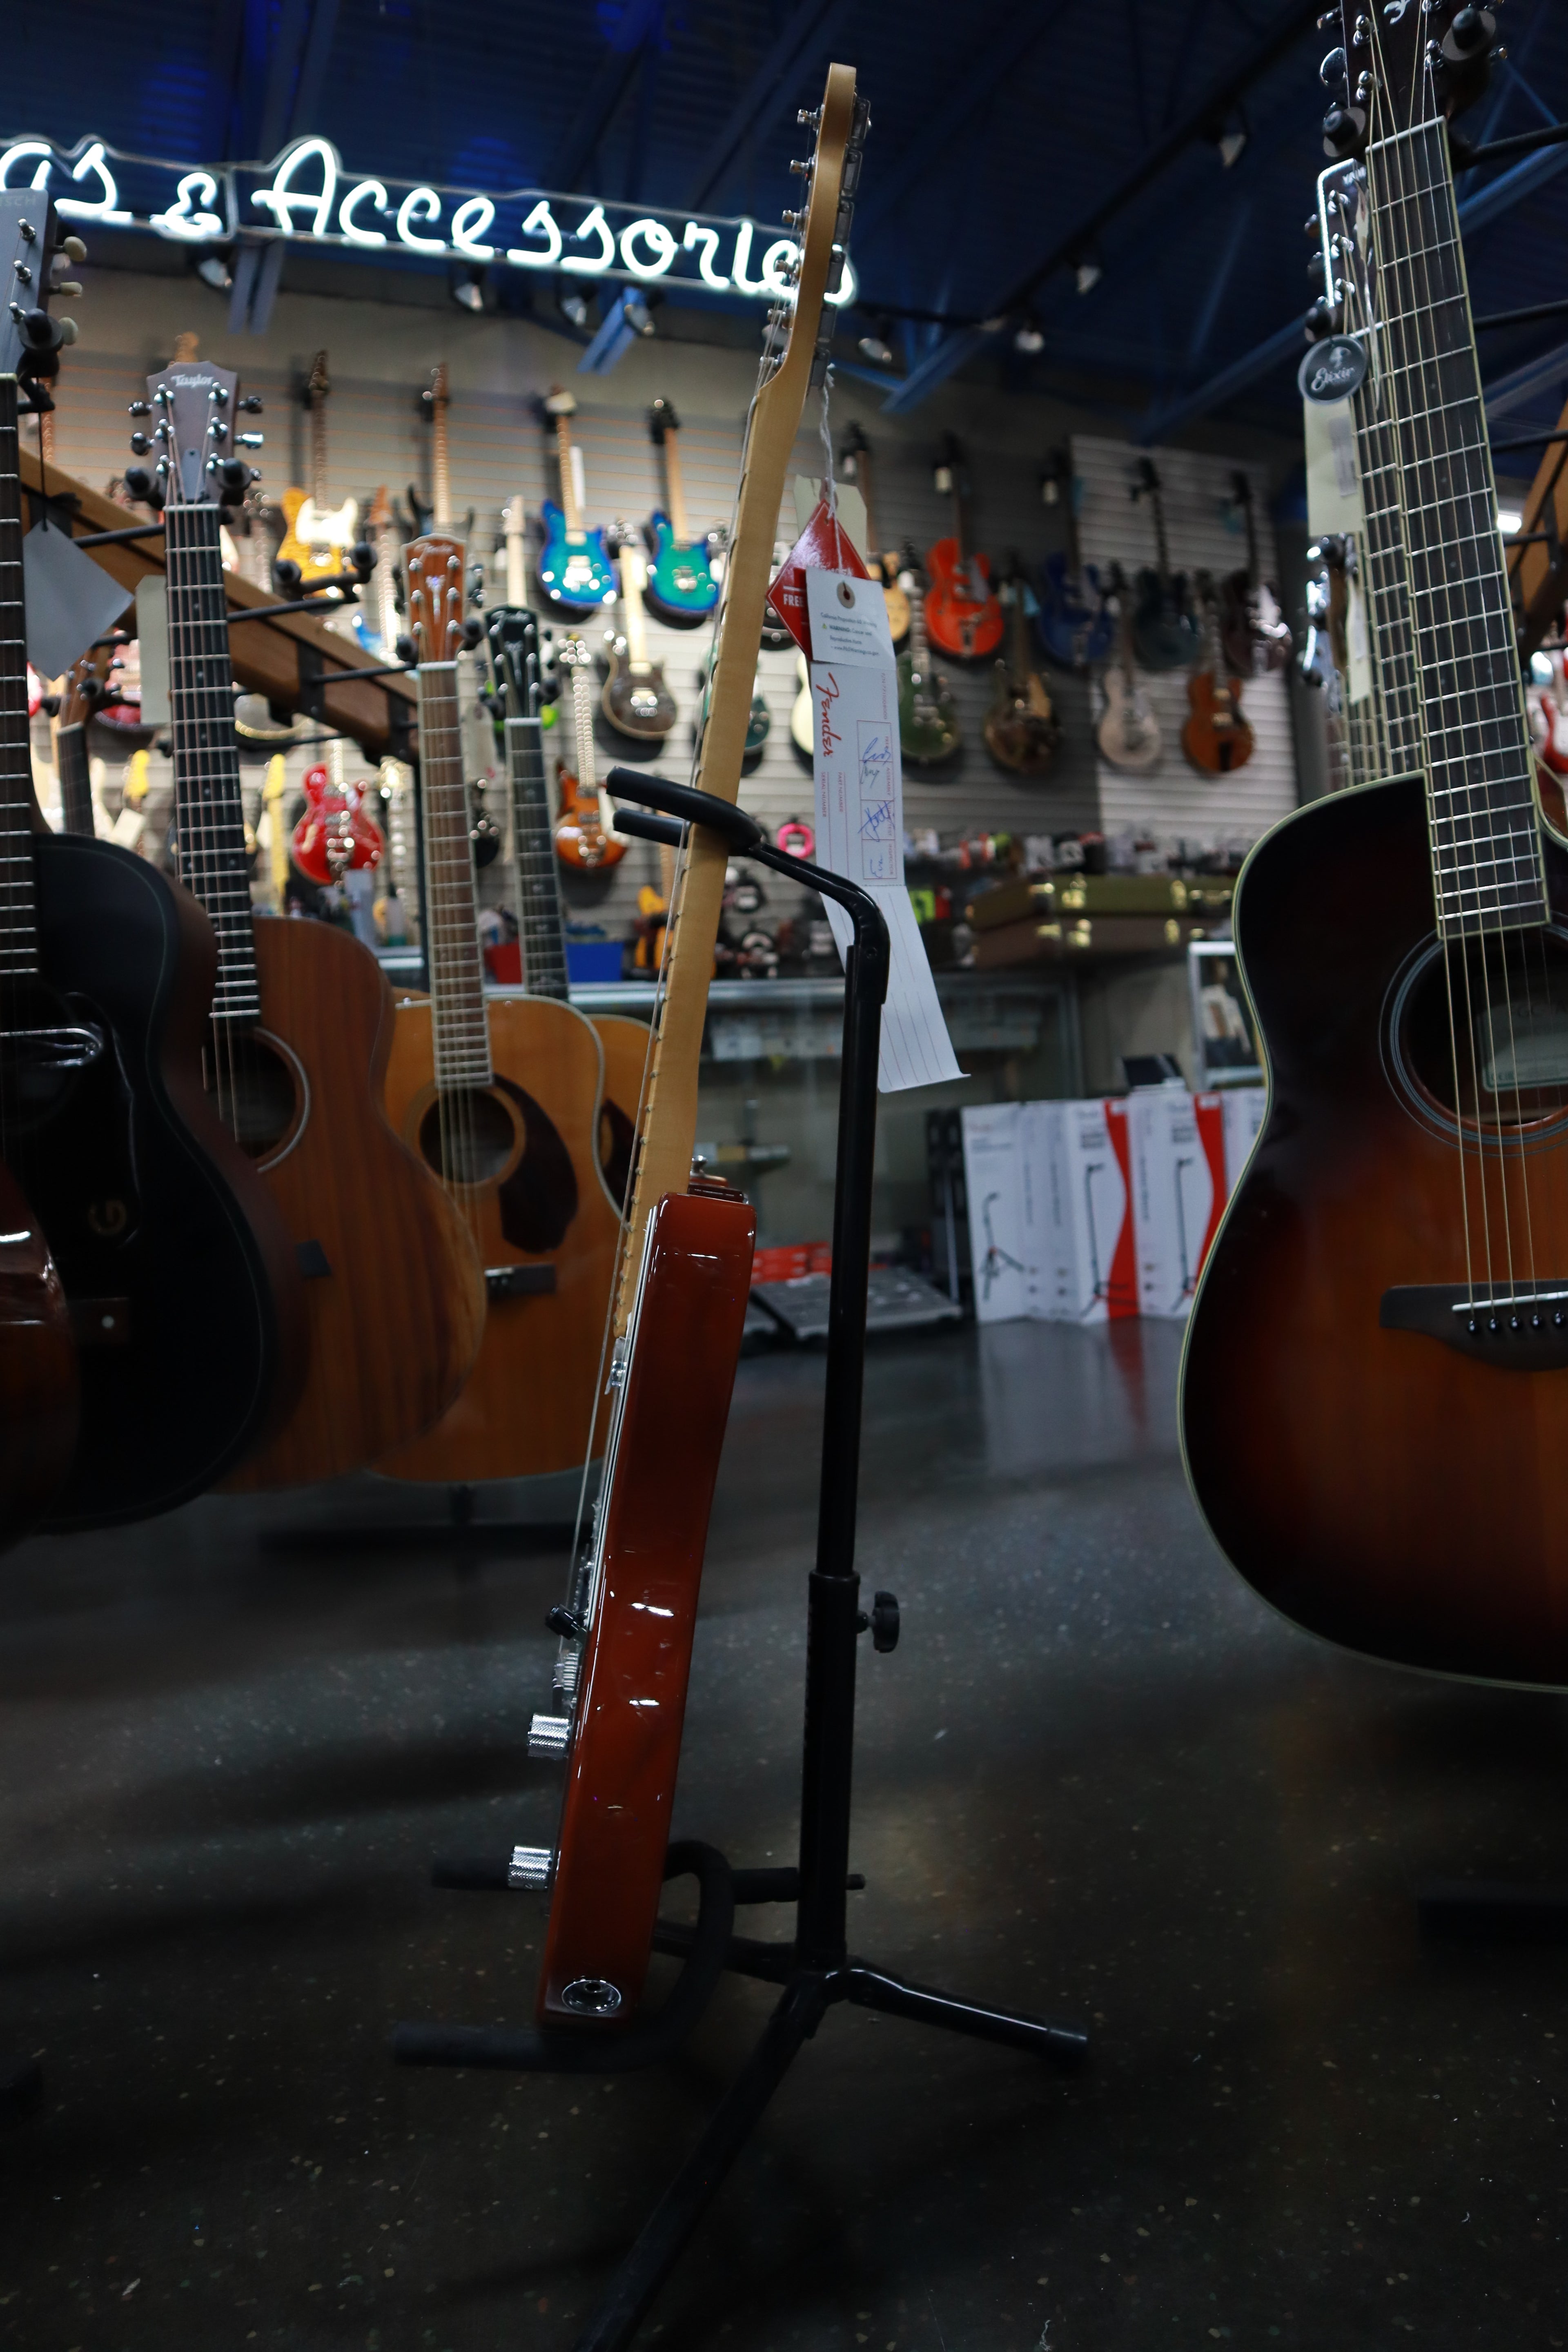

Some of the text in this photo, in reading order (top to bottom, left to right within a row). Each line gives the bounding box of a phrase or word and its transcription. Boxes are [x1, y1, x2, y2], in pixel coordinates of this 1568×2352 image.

[149, 171, 223, 237] &
[250, 139, 854, 304] Accessories
[170, 374, 214, 388] Taylor
[783, 593, 804, 607] FREE
[816, 672, 842, 757] Fender
